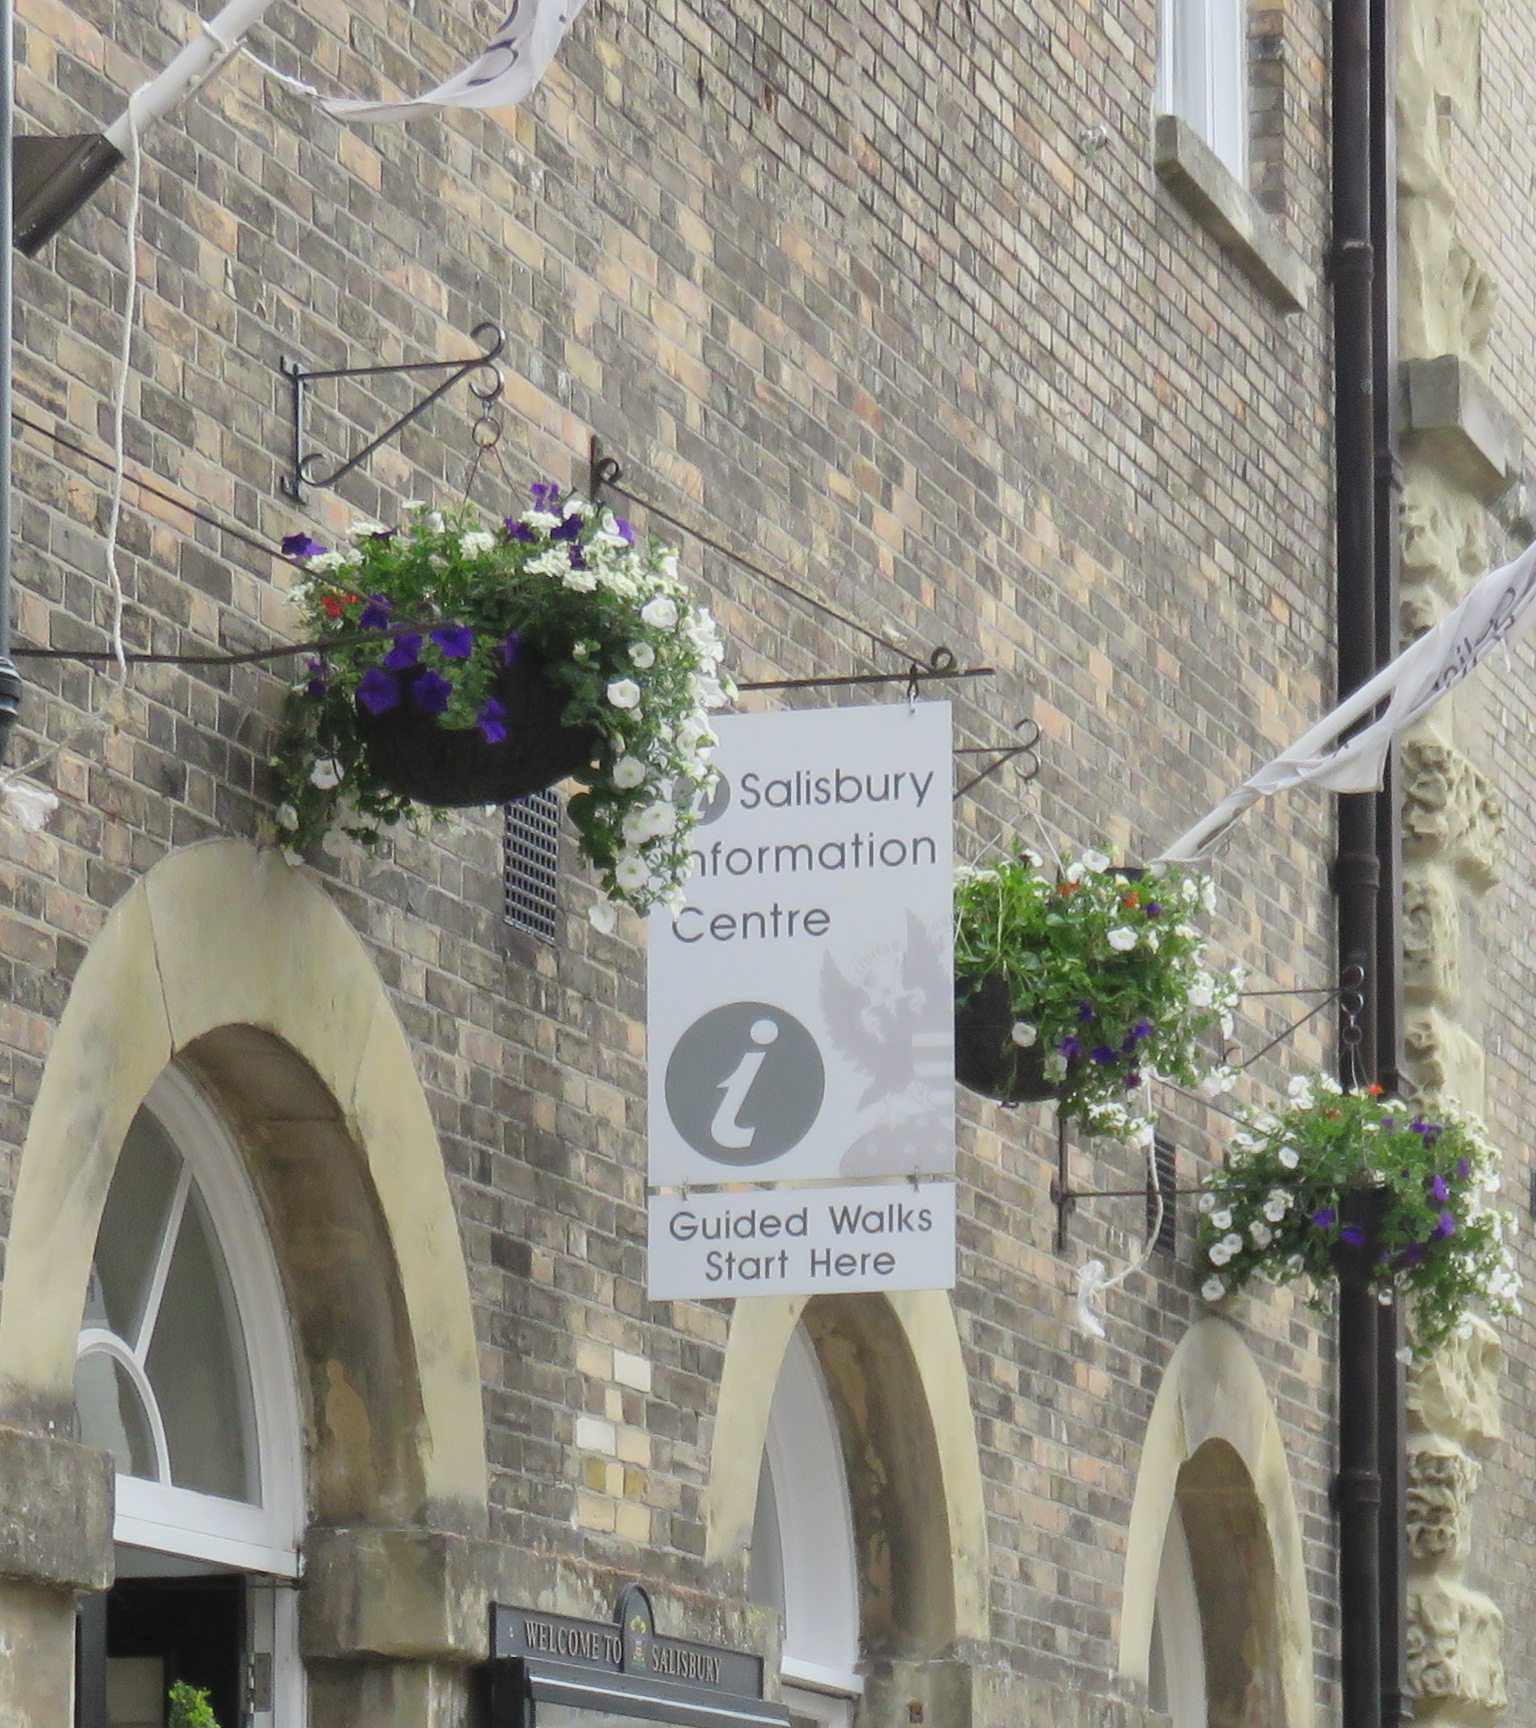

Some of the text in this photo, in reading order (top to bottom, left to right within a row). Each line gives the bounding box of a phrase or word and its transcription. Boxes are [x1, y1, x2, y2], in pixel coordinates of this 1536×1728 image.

[739, 768, 935, 810] Salisbury
[671, 902, 831, 943] Centre
[669, 1203, 933, 1241] Guided Walks
[705, 1248, 896, 1282] Start Here
[525, 1620, 723, 1684] WELCOME TO SALISBURY
